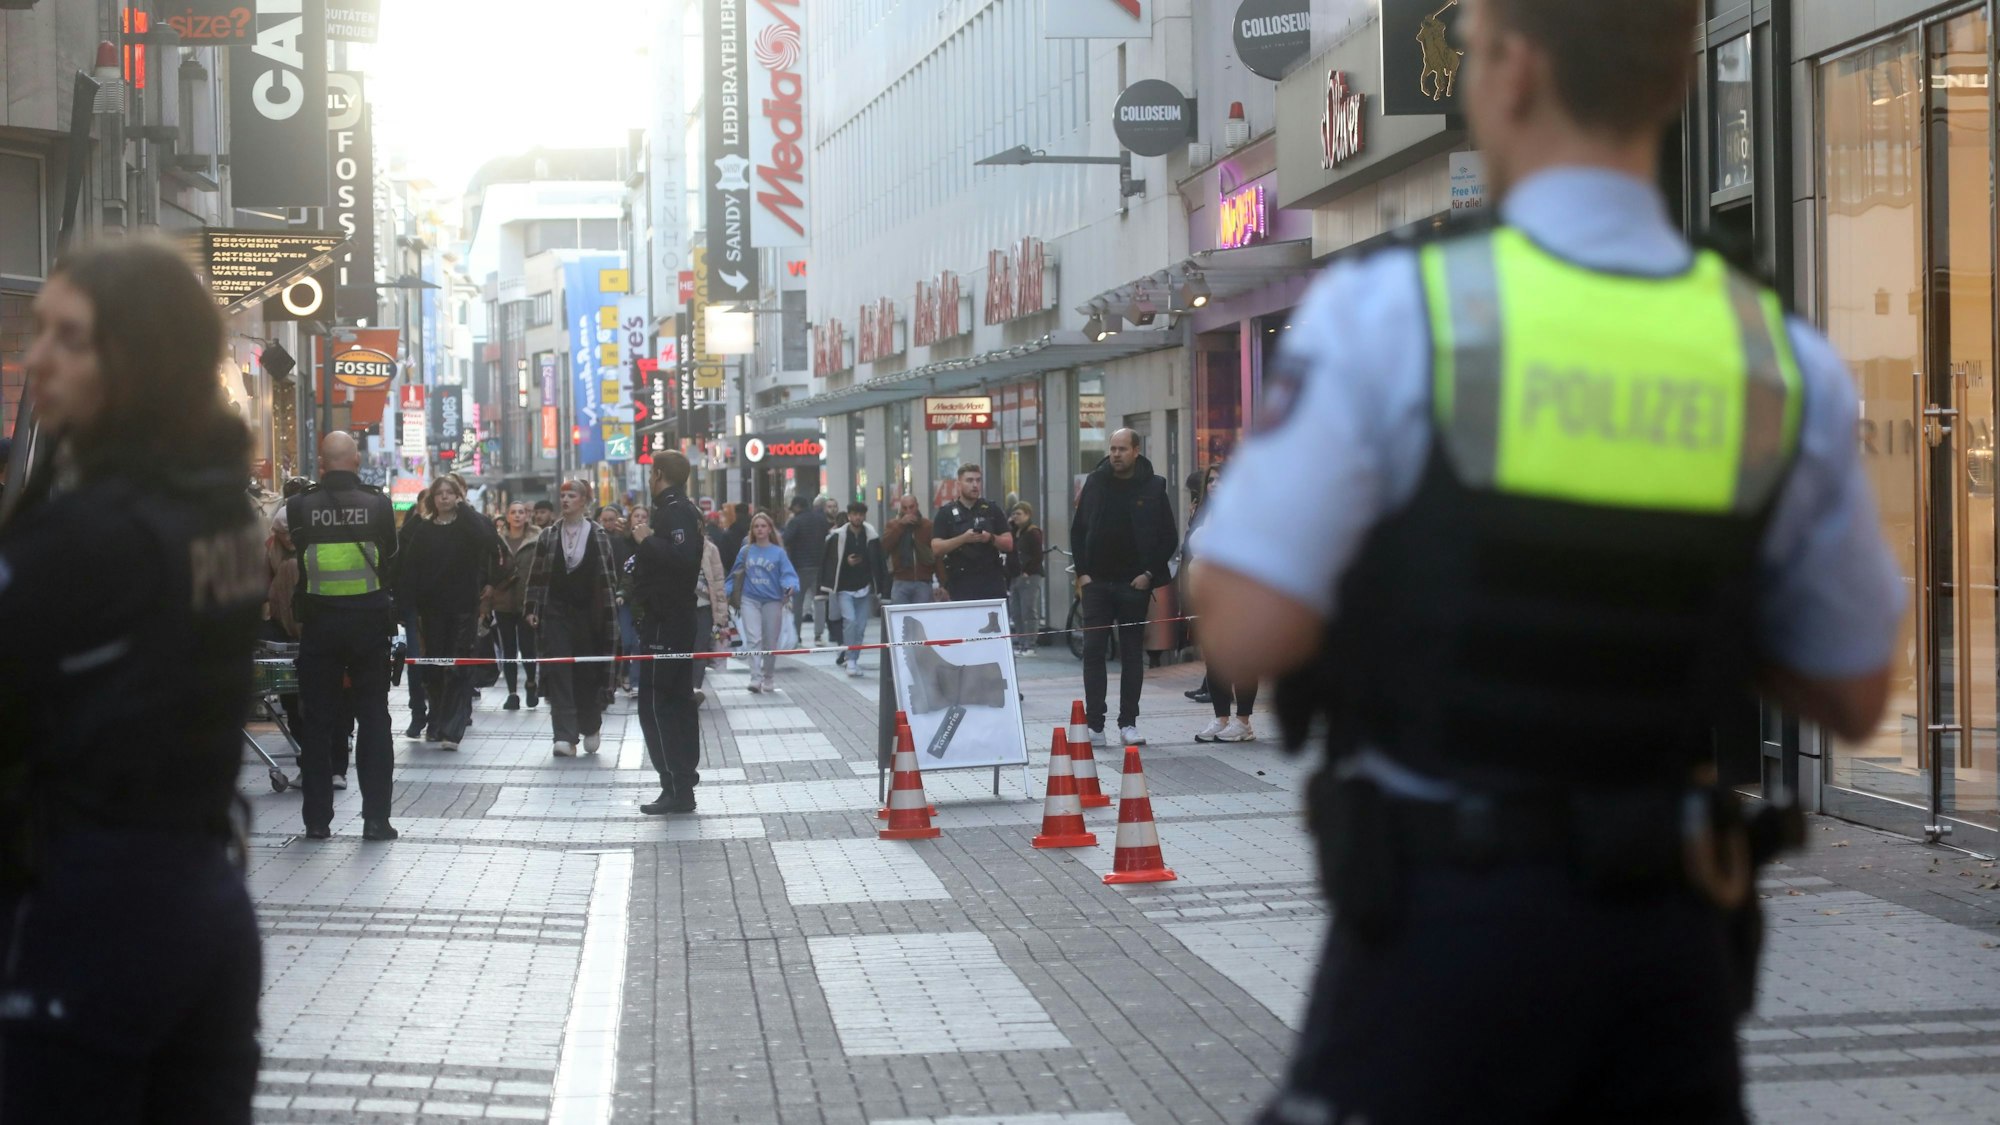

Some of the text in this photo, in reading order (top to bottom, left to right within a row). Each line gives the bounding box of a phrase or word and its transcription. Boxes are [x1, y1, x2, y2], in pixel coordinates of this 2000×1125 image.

[169, 7, 251, 38] size?
[252, 0, 303, 120] CA
[1120, 105, 1181, 121] COLLOSEUM
[1452, 186, 1469, 197] Free
[1452, 197, 1482, 209] für alle!
[724, 194, 742, 262] SANDY
[212, 237, 337, 245] GESCHENKARTIKEL
[335, 361, 390, 376] FOSSIL
[1521, 362, 1726, 450] POLIZEI
[311, 508, 369, 527] POLIZEI
[933, 711, 960, 752] tamaris
